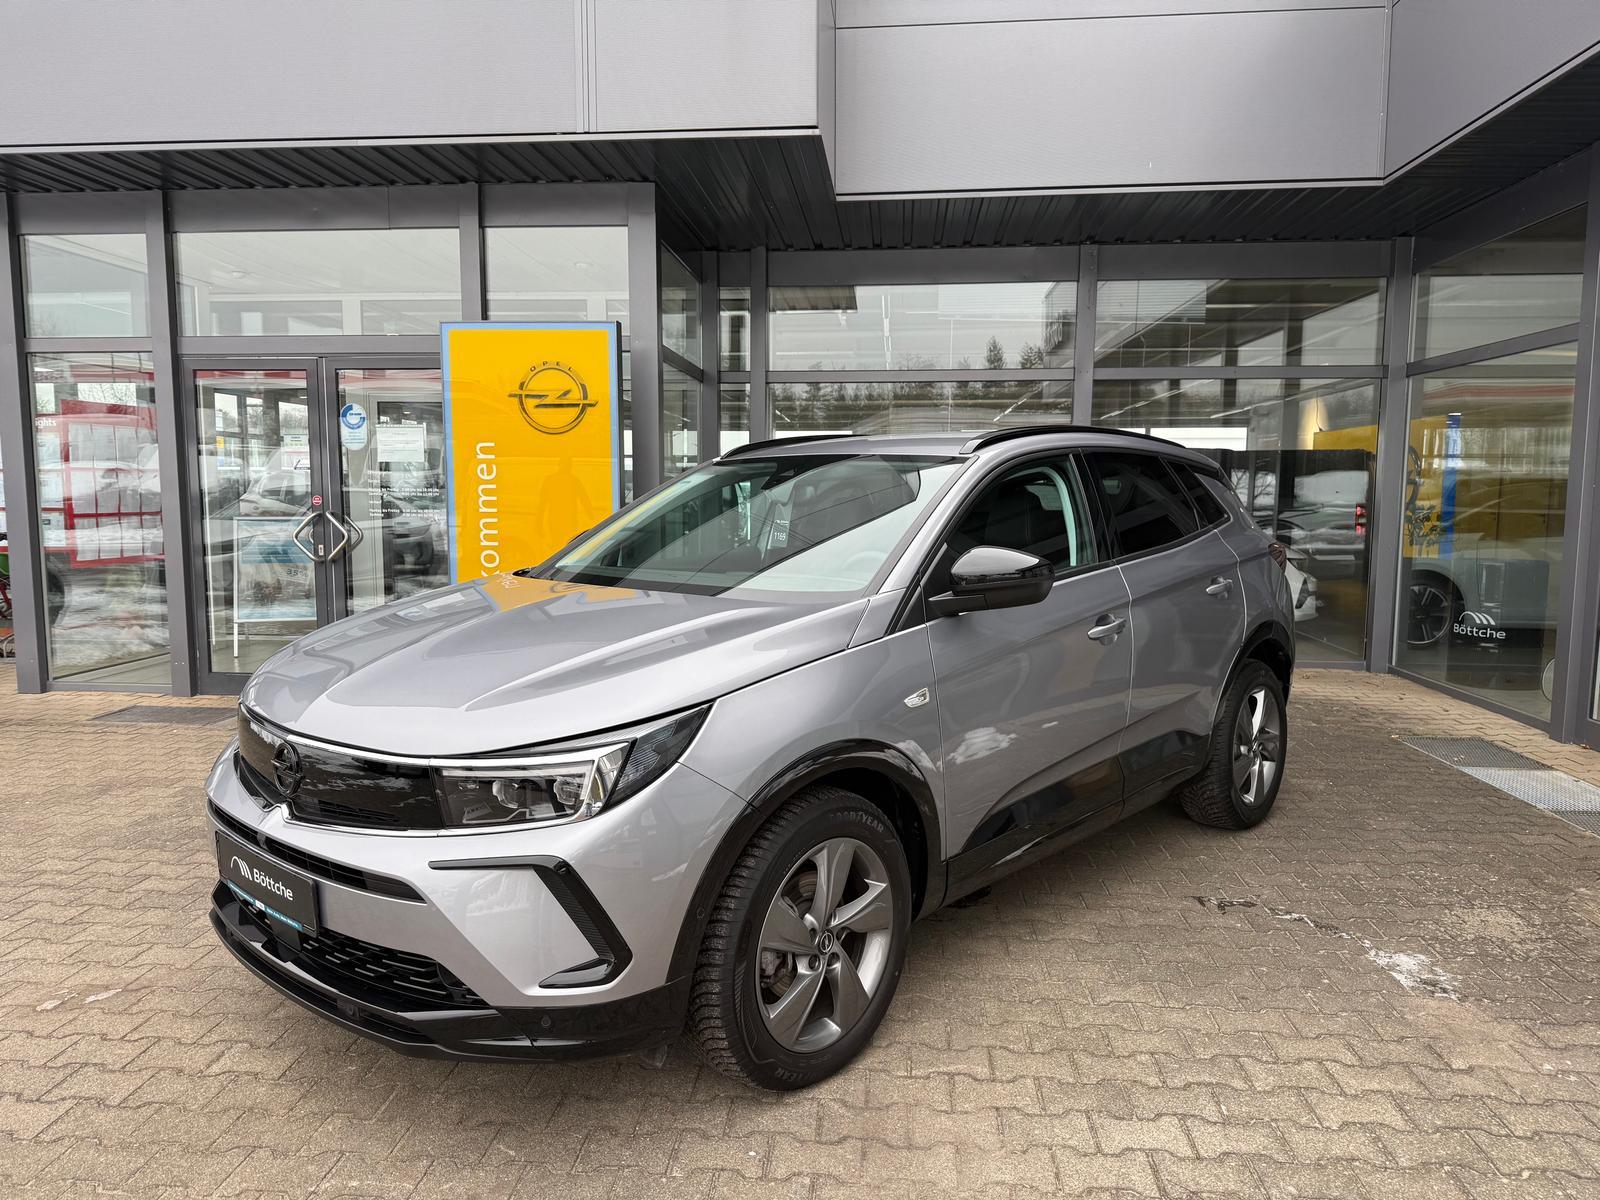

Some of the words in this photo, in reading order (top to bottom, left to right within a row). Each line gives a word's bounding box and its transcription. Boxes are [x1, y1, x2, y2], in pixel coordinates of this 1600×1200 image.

[529, 361, 573, 373] OPEL
[1453, 623, 1506, 639] Böttche
[253, 868, 294, 901] Böttche
